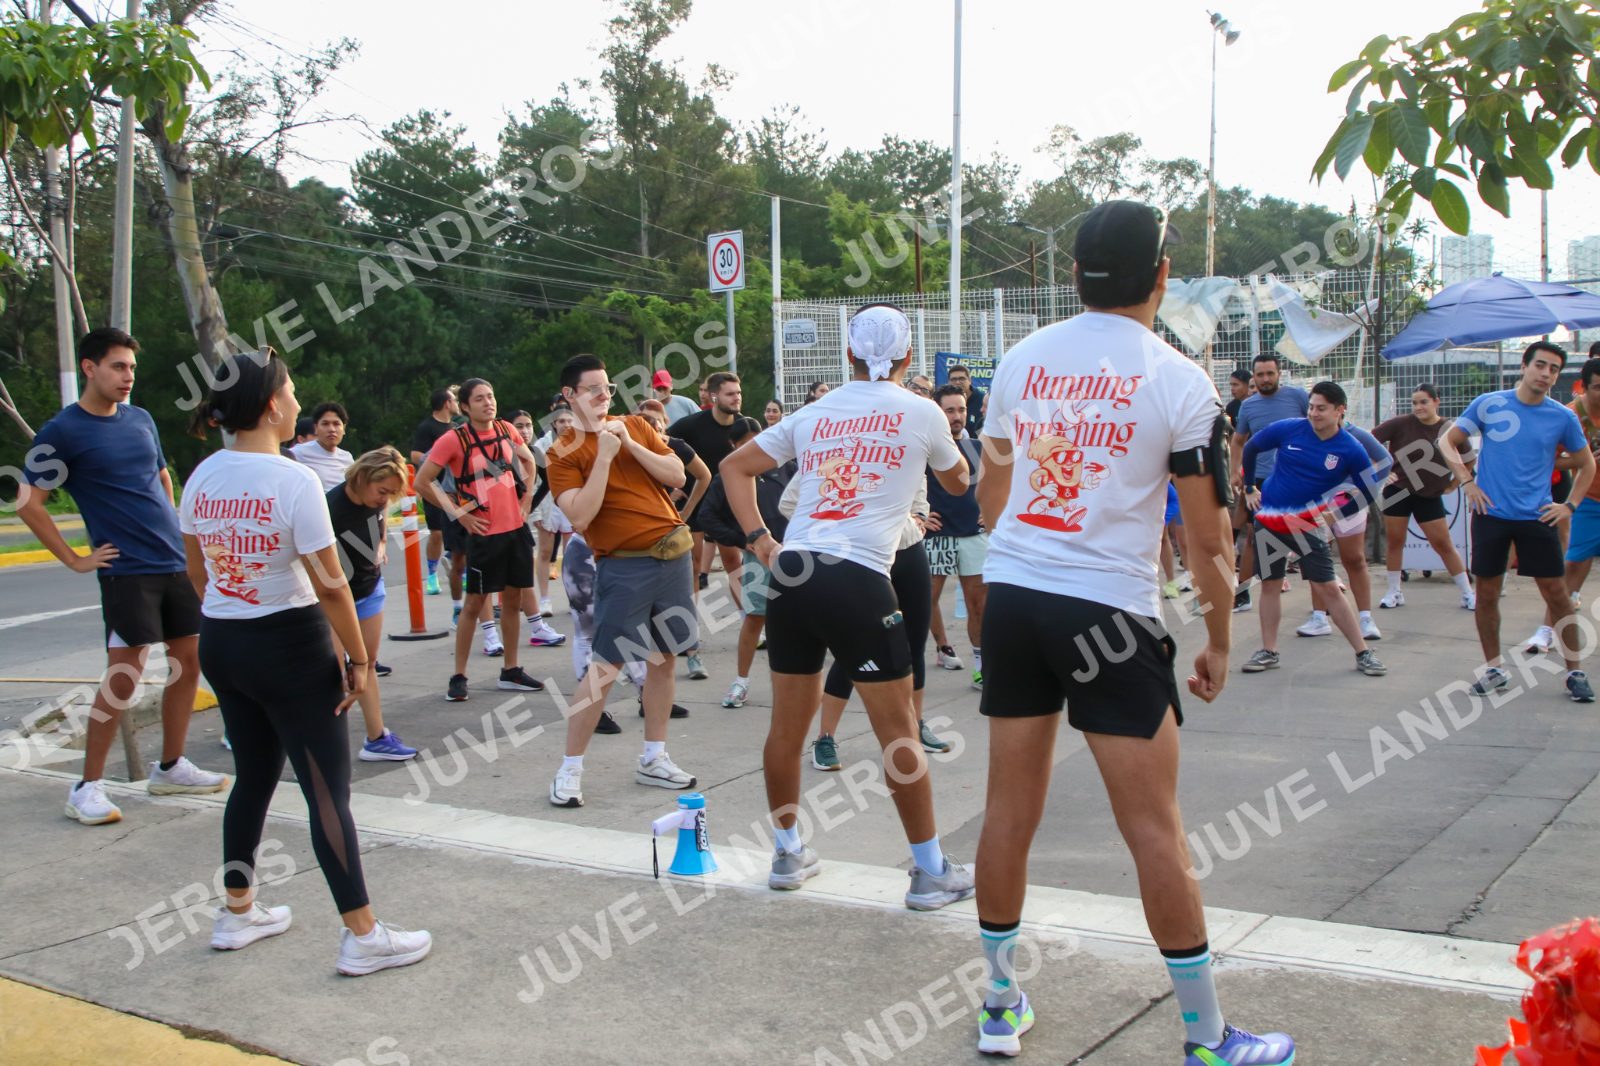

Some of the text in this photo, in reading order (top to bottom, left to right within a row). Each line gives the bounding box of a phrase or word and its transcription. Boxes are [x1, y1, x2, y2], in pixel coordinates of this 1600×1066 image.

[720, 248, 733, 268] 30
[946, 357, 993, 368] CURSOS
[1020, 366, 1143, 410] Running
[810, 409, 905, 442] Running
[194, 491, 276, 526] Running
